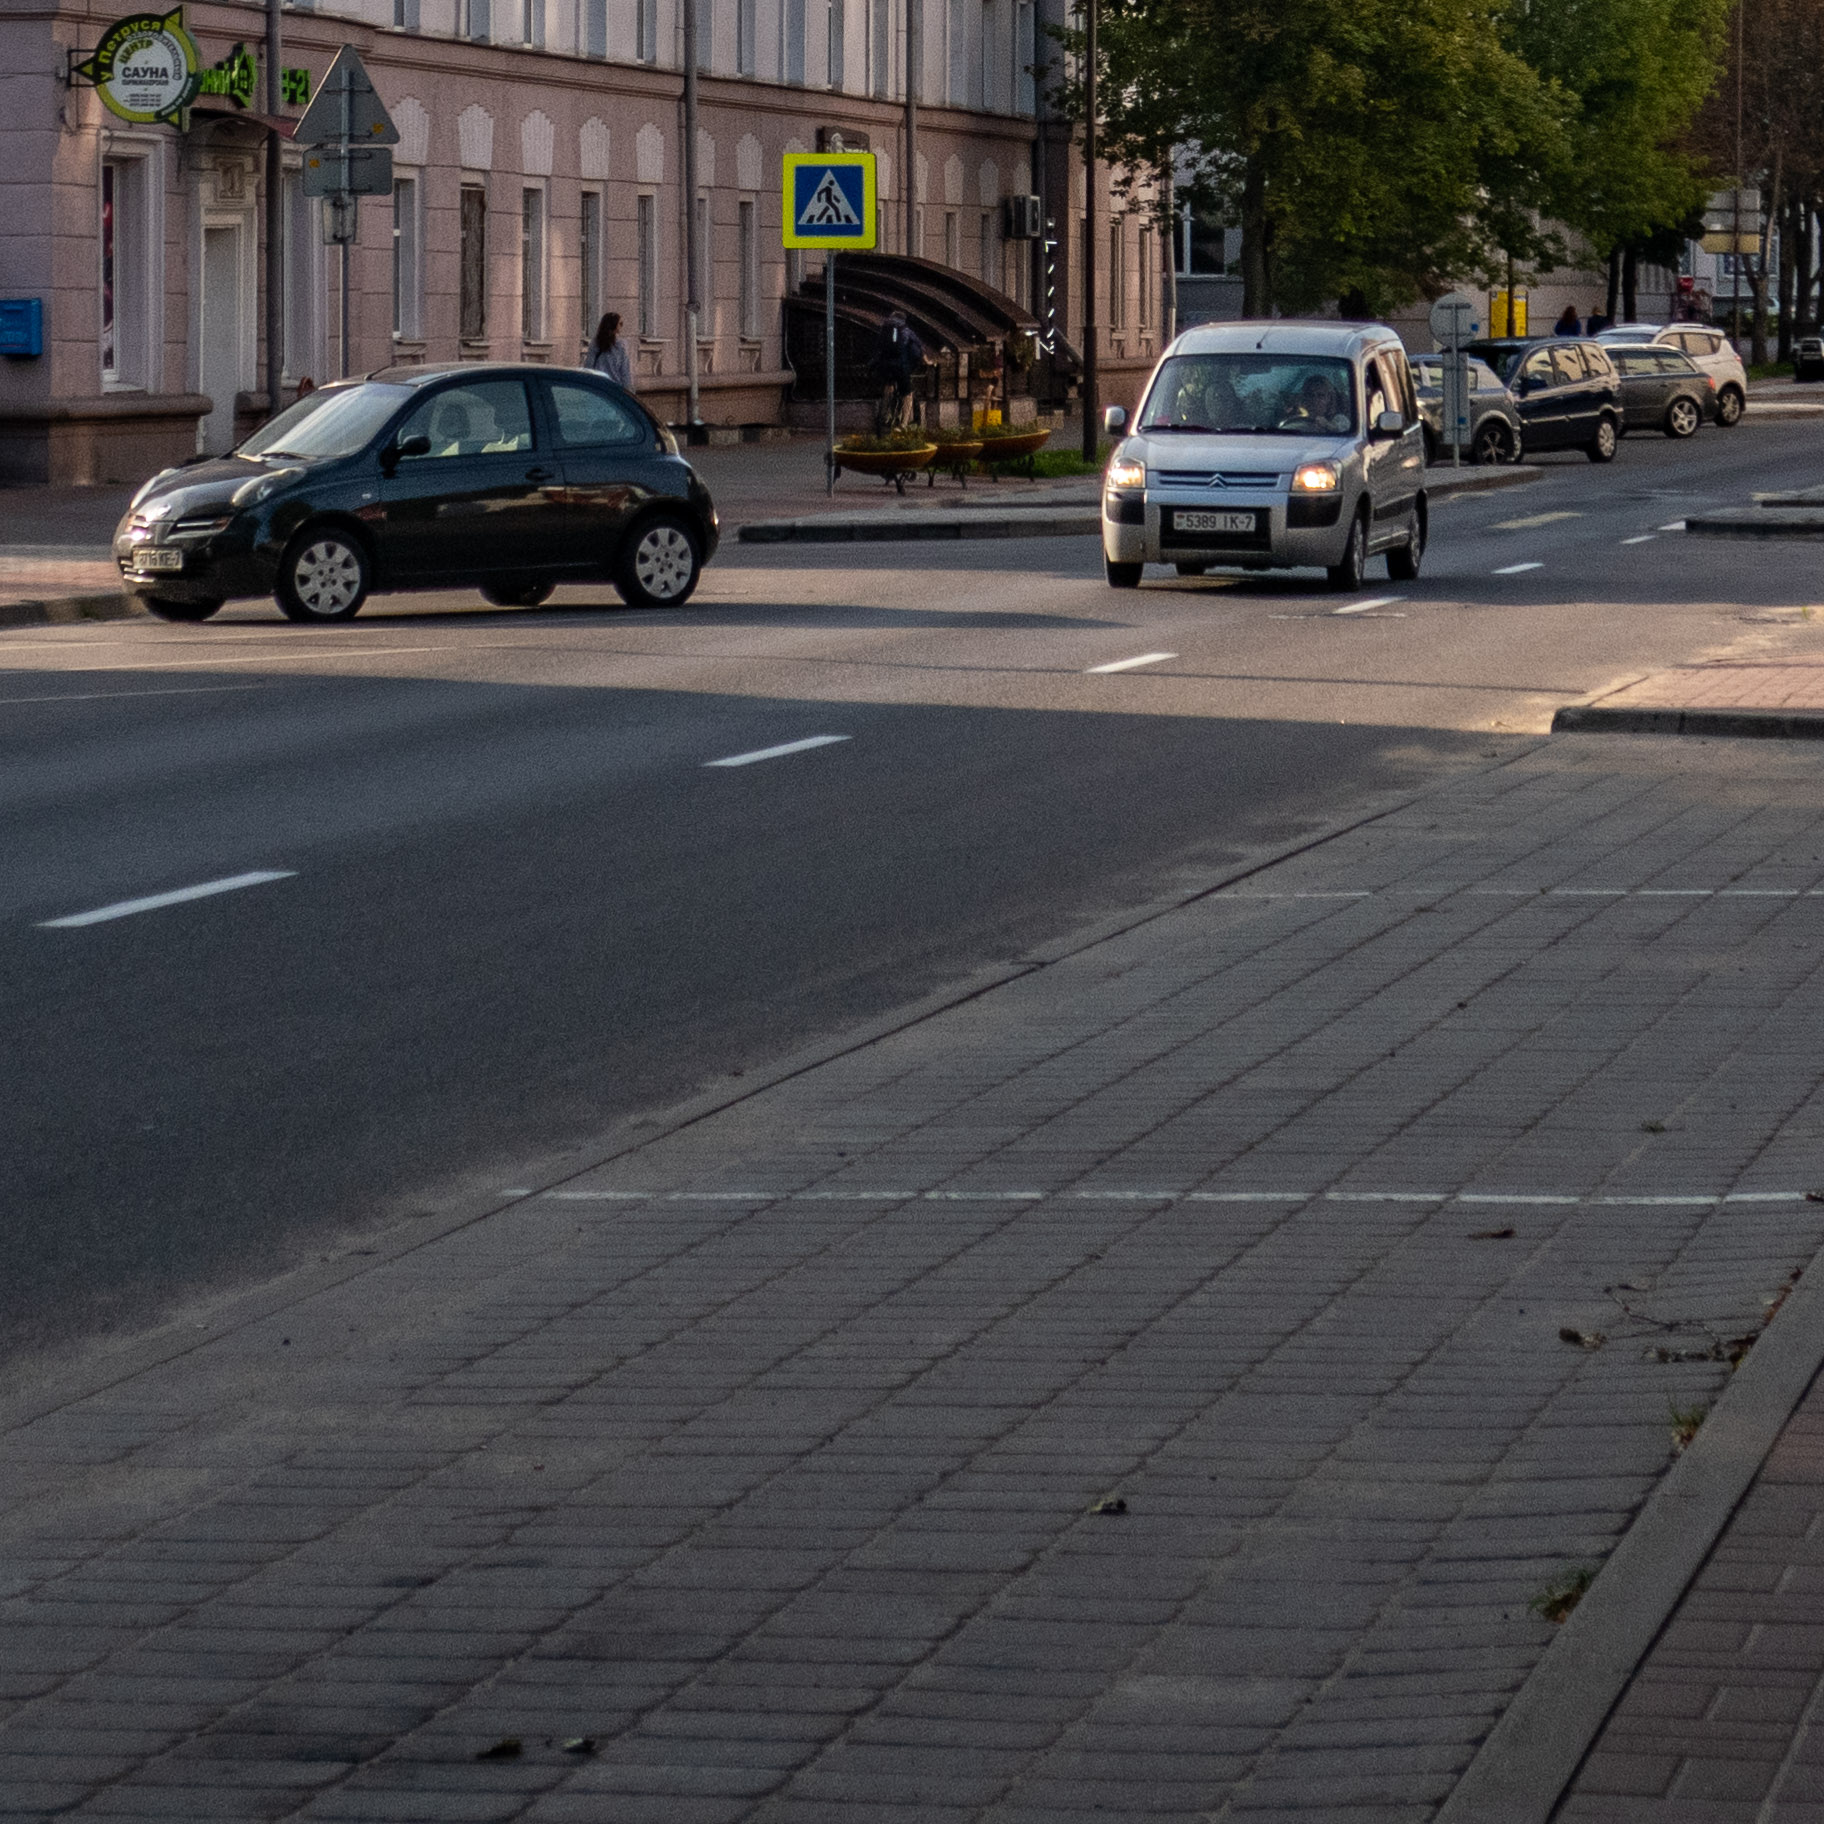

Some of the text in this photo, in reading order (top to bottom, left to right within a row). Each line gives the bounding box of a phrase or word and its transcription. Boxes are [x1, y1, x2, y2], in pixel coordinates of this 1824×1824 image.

[97, 20, 162, 64] Петруся
[118, 38, 154, 65] ЦЕНТР
[122, 66, 169, 78] САУНА
[1186, 514, 1253, 529] 5389 IK-7
